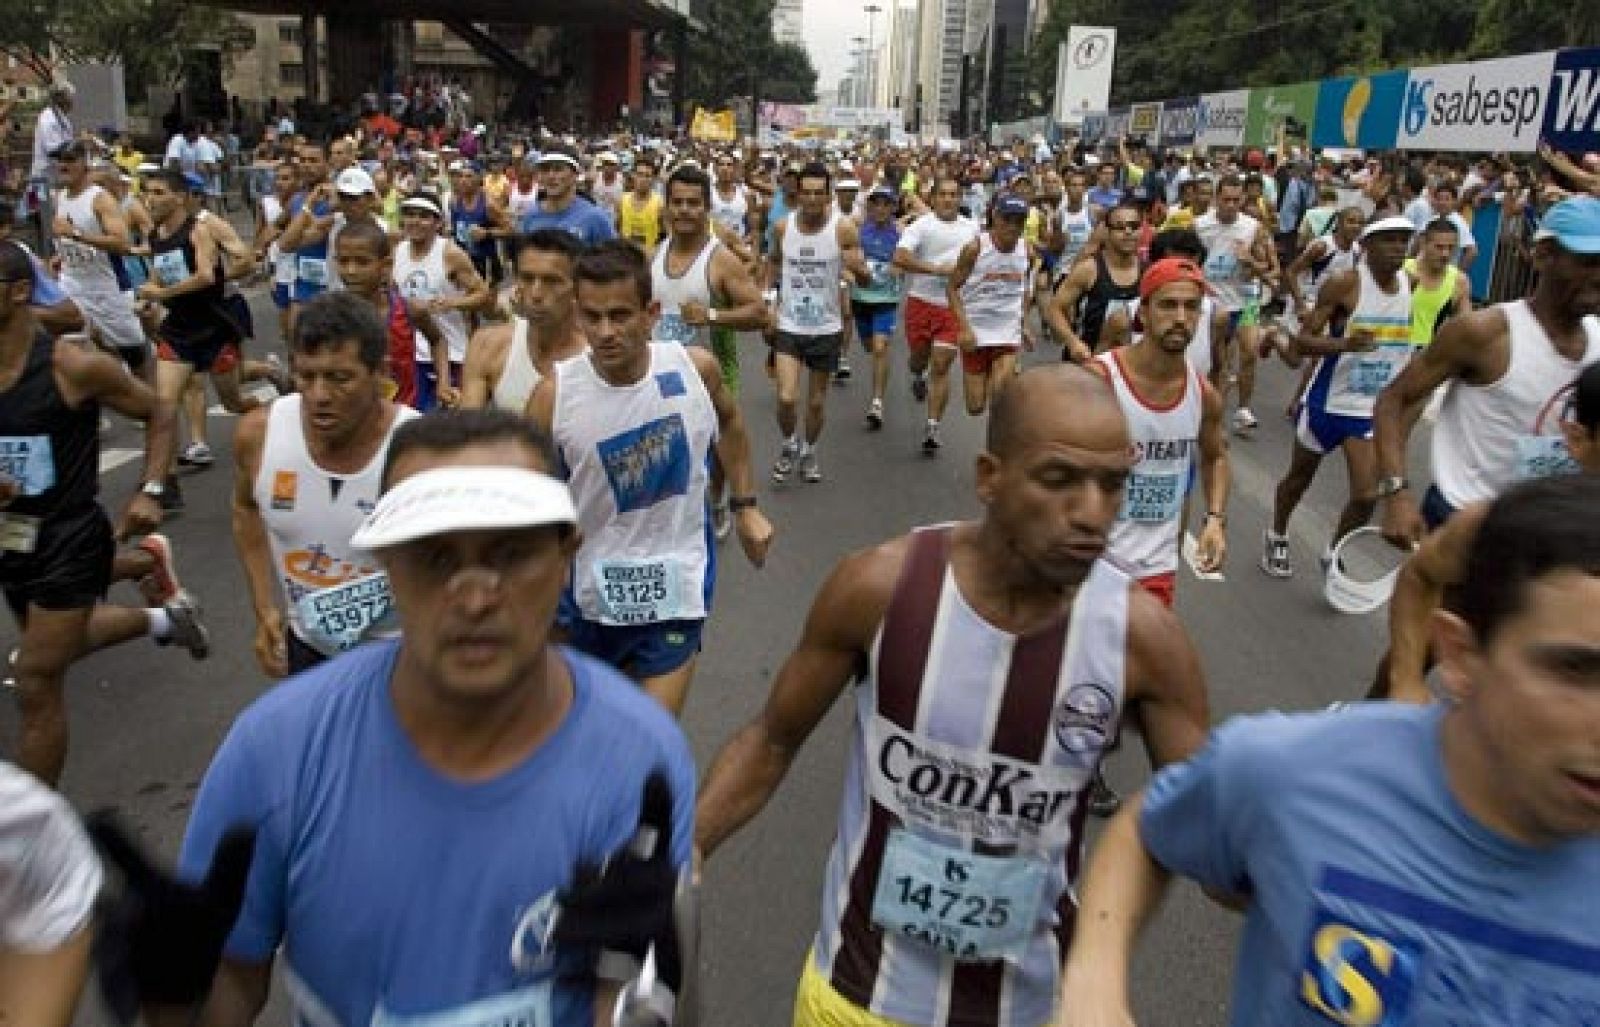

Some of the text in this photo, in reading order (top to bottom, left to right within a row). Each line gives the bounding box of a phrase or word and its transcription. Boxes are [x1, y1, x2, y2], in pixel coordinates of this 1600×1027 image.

[1431, 75, 1540, 138] sabesp
[604, 581, 667, 603] 13125
[879, 735, 1071, 824] ConKar
[896, 876, 1010, 928] 14725
